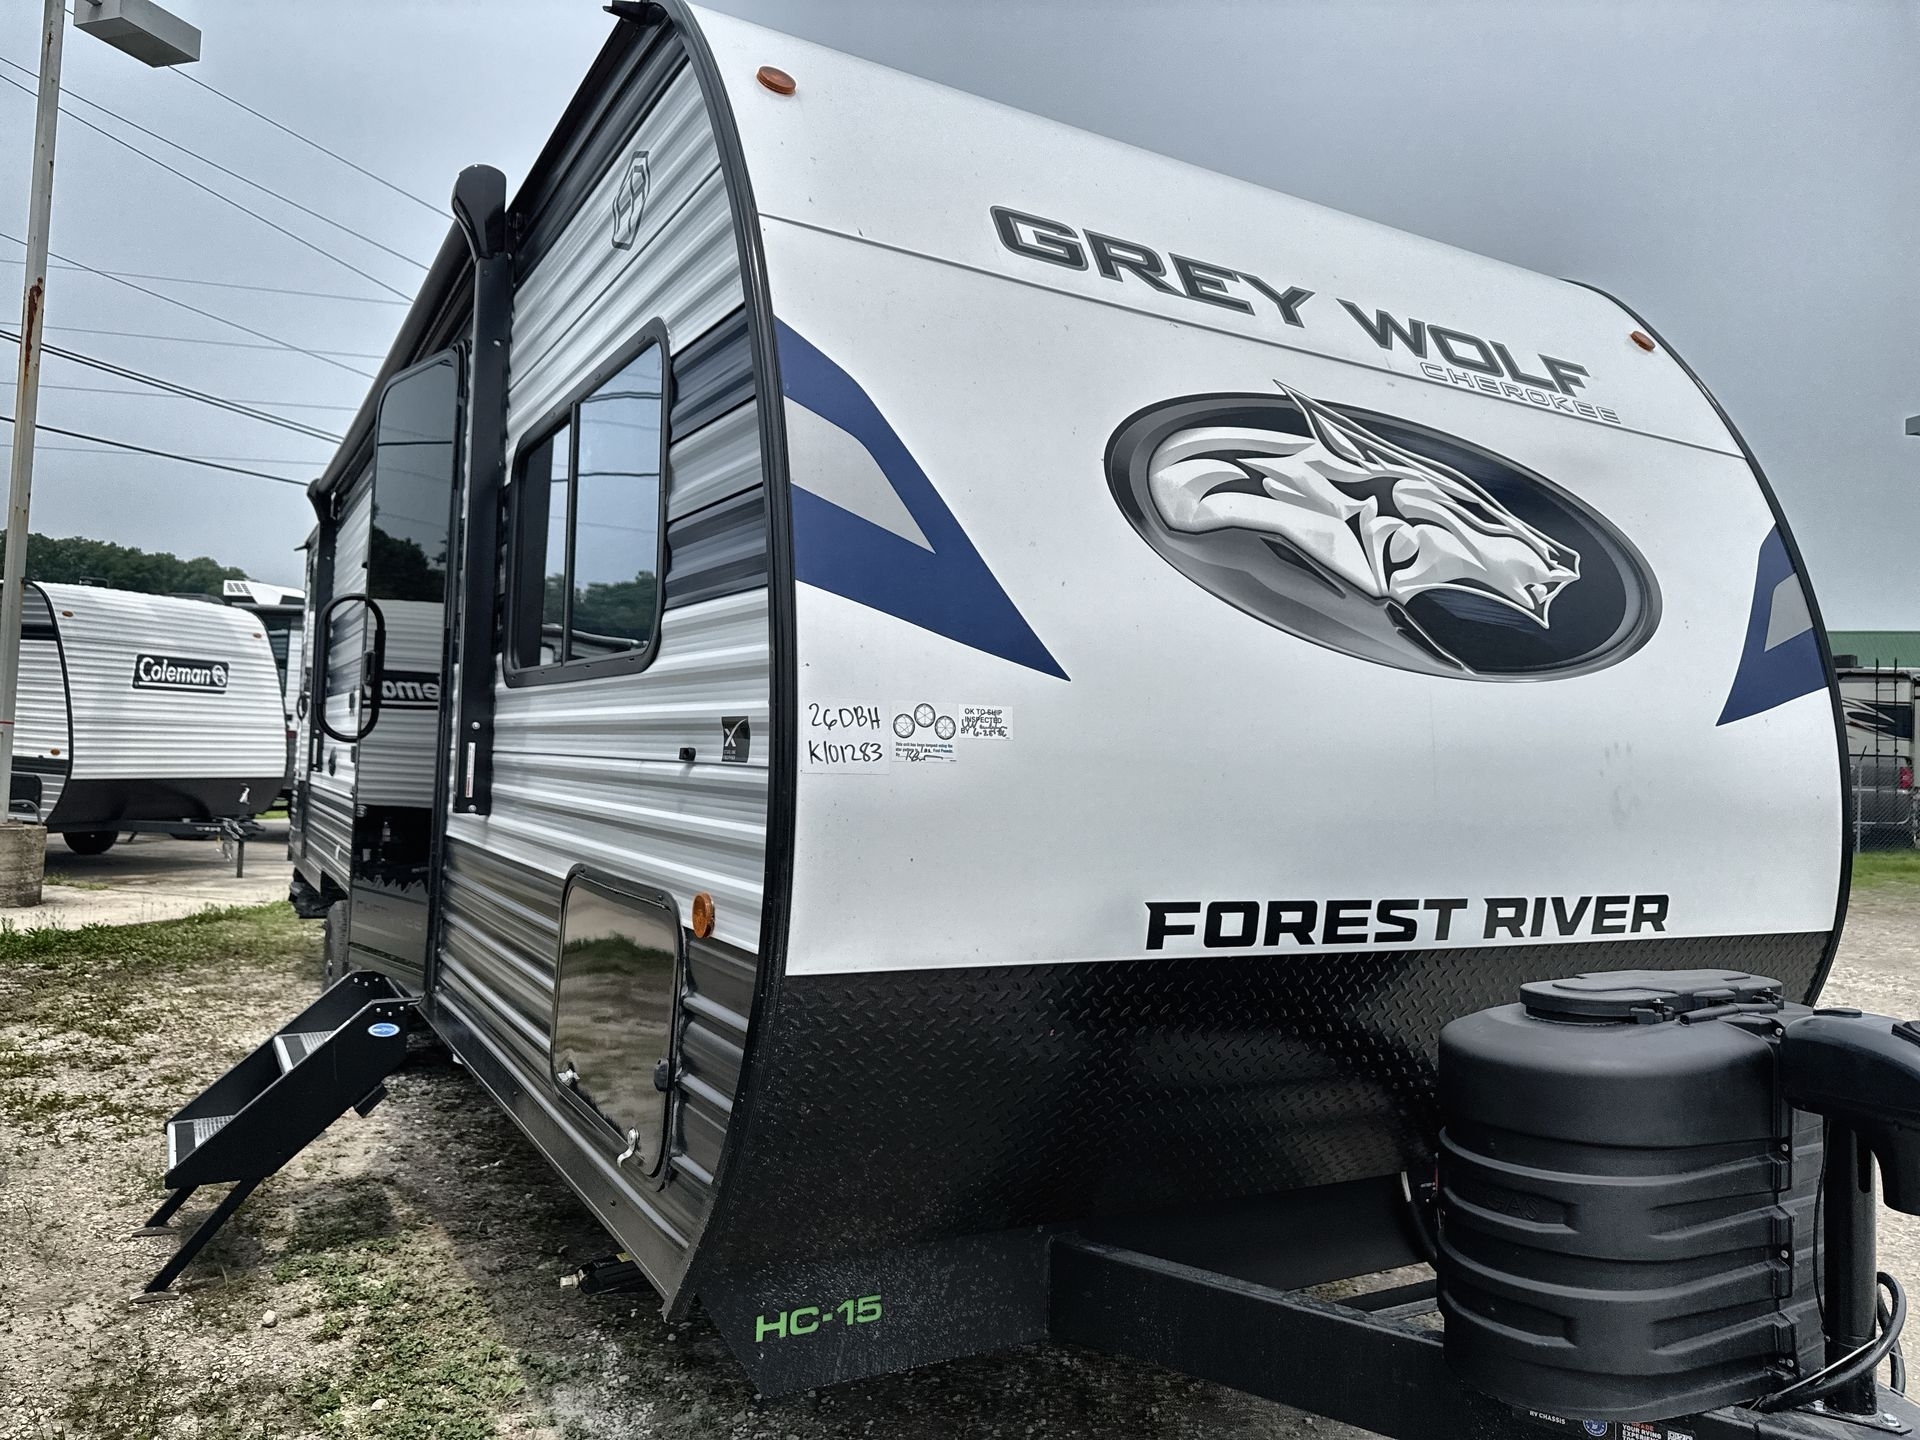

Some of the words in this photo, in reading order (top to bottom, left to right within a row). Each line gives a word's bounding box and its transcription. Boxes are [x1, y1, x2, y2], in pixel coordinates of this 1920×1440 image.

[990, 205, 1315, 328] GREY
[1335, 298, 1591, 397] WOLF
[1420, 362, 1622, 424] CHEROKEE
[139, 656, 211, 685] Coleman
[808, 703, 881, 731] 26DBH
[964, 716, 1003, 724] INSPECTED
[808, 740, 883, 765] K101283
[1145, 898, 1469, 950] FOREST
[1483, 894, 1670, 940] RIVER
[755, 1294, 883, 1343] HC-15
[1538, 1412, 1566, 1425] CHASSIS
[1622, 1423, 1640, 1433] YOUR
